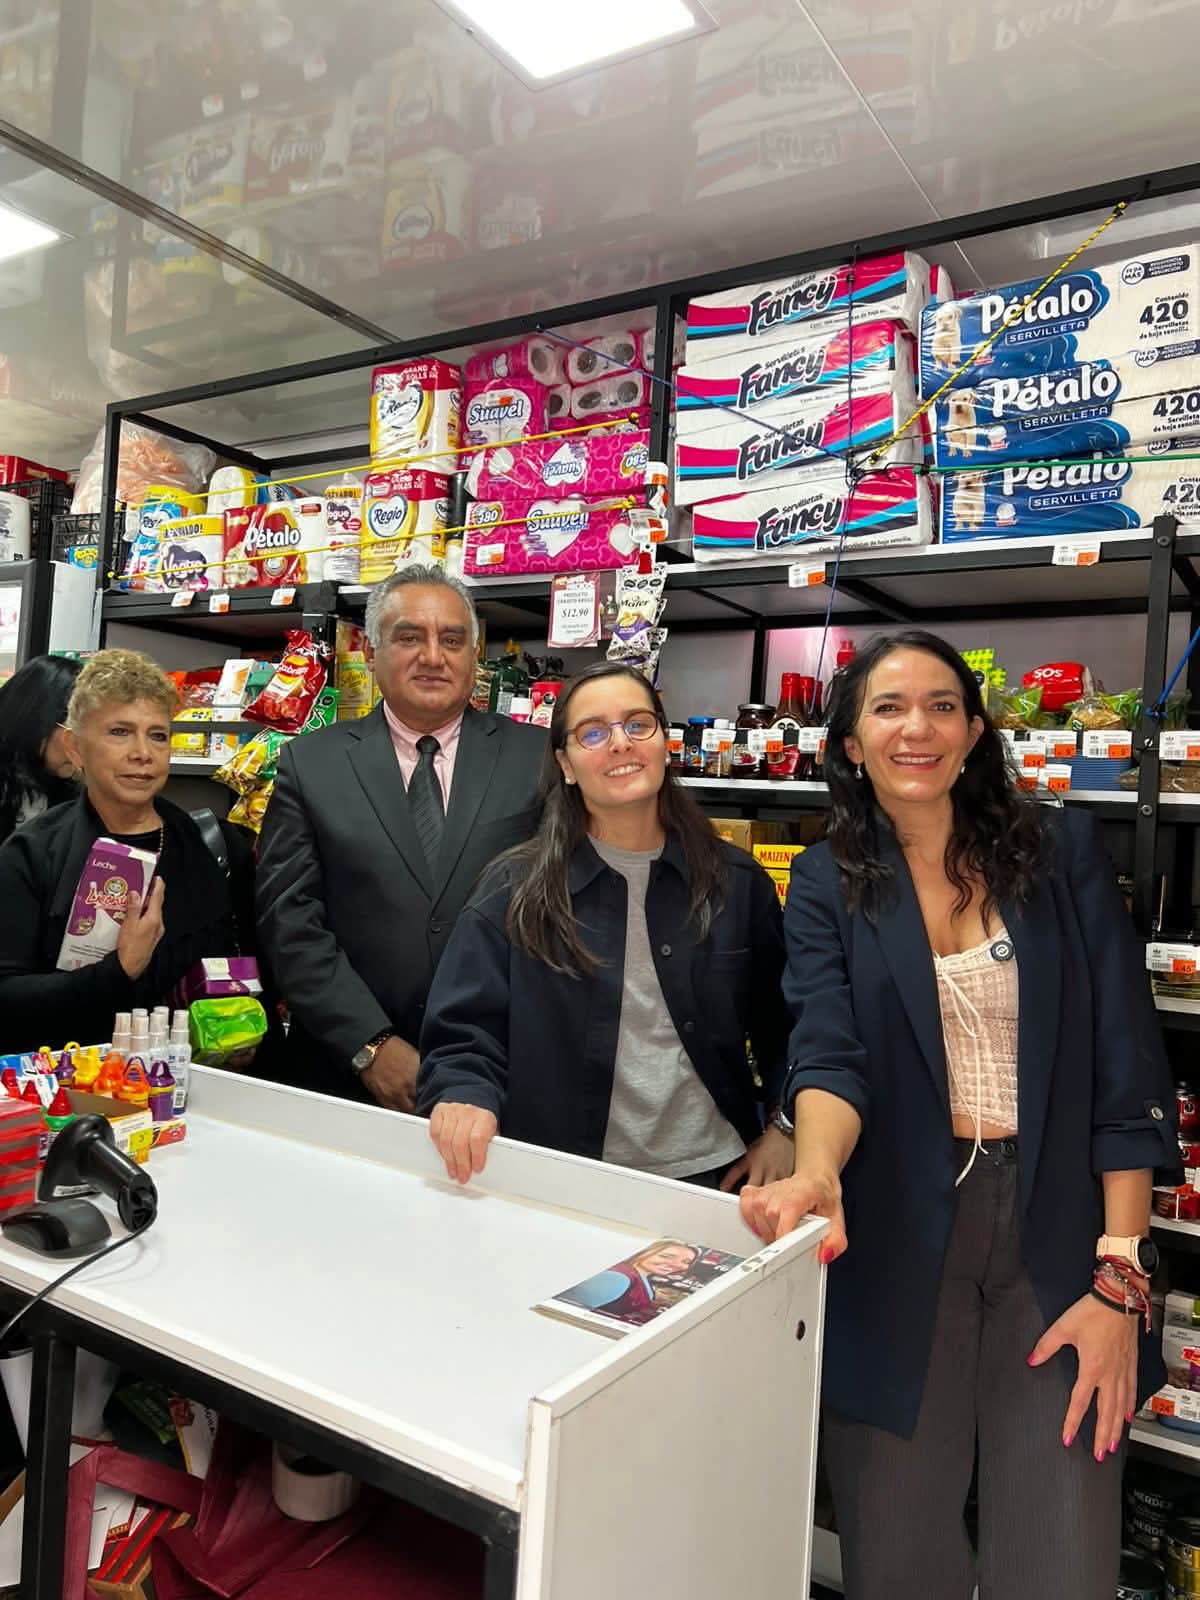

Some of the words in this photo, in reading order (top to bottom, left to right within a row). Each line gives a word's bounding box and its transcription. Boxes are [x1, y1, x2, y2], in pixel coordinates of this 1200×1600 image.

[749, 275, 837, 336] Fancy
[980, 284, 1093, 334] Pétalo
[1139, 299, 1189, 325] 420
[1009, 320, 1086, 343] SERVILLETA
[738, 348, 825, 409] Fancy
[991, 364, 1118, 418] Pétalo
[468, 399, 524, 426] Suavel
[1153, 391, 1200, 417] 420
[1023, 406, 1108, 429] SERVILLETA
[738, 420, 825, 480] Fancy
[783, 492, 824, 514] Servilletas
[1033, 489, 1118, 507] SERVILLETA
[374, 506, 403, 525] Regio
[755, 498, 844, 551] Fancy
[246, 525, 300, 552] Pétalo
[561, 608, 589, 618] $12.90
[1033, 667, 1064, 679] SOS
[92, 858, 118, 871] Leche
